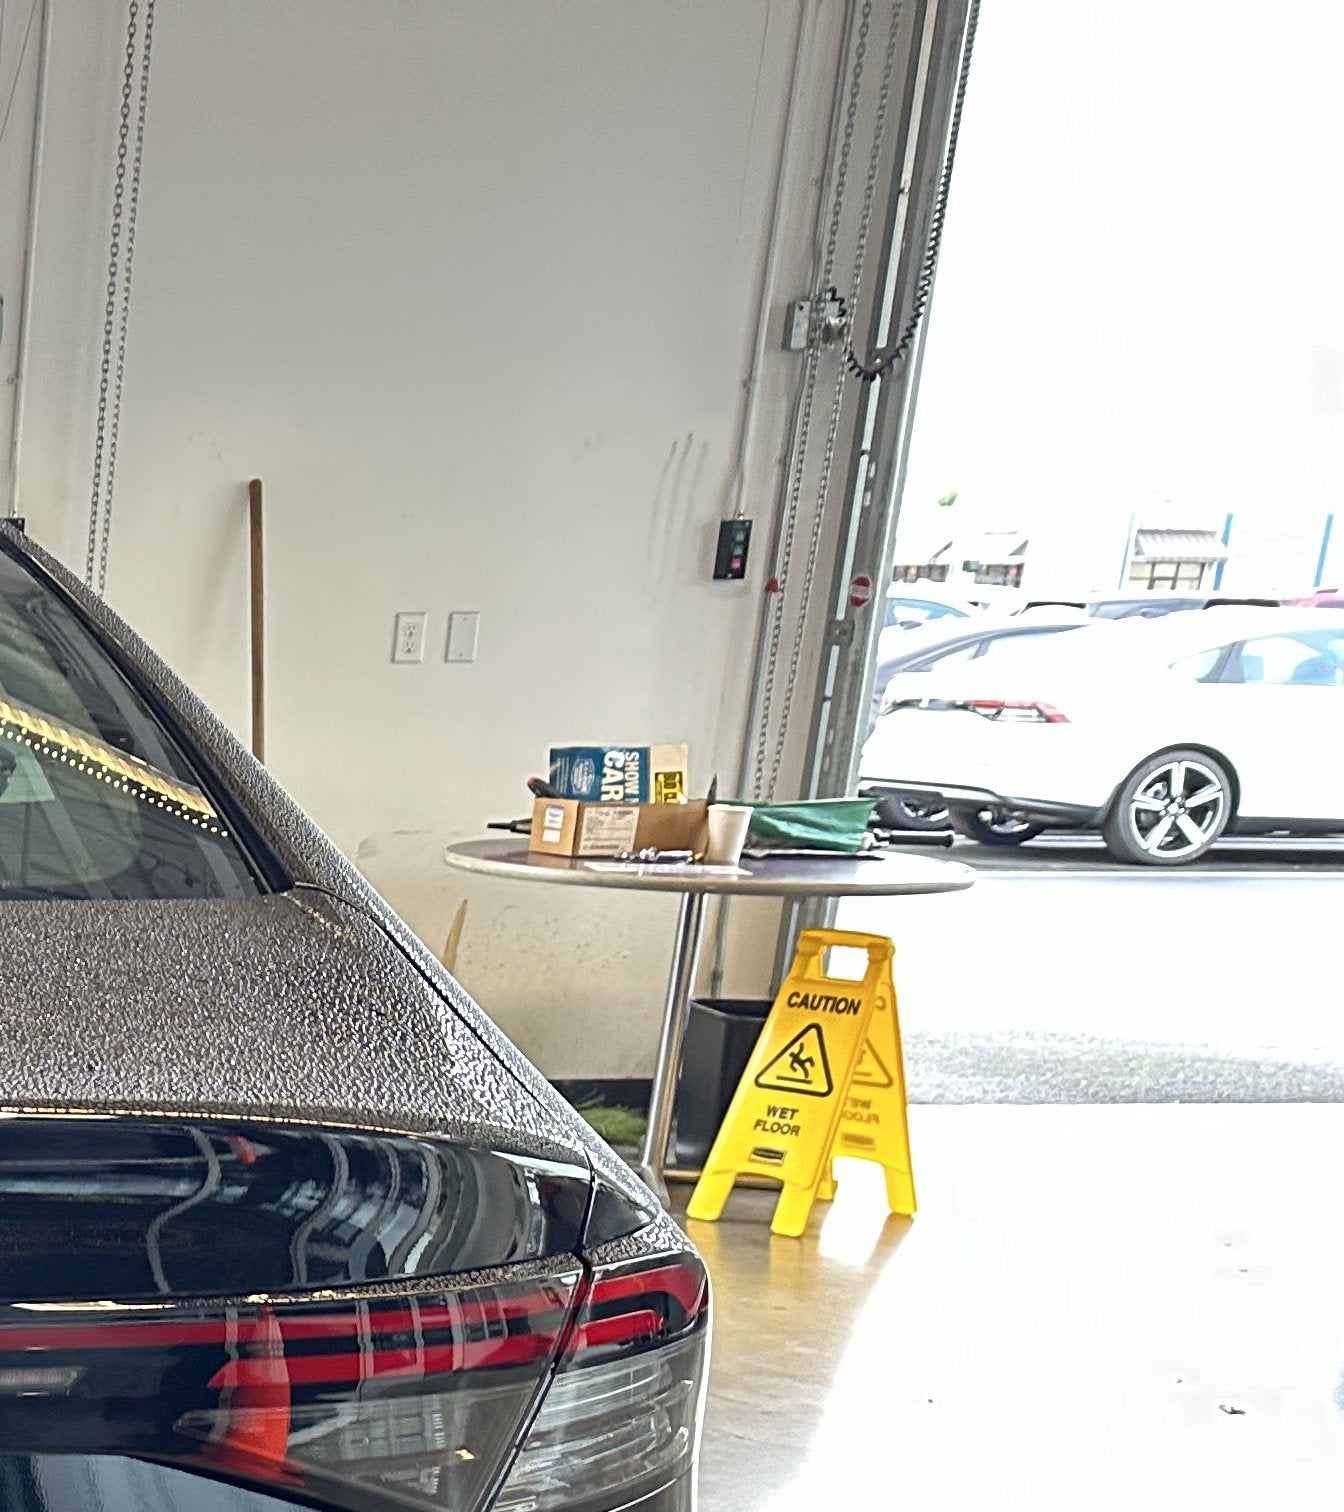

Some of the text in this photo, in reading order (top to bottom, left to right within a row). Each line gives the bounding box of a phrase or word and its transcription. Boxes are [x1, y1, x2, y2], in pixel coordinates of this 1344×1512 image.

[601, 750, 625, 801] CAR
[625, 751, 640, 792] SHOW
[787, 991, 862, 1016] CAUTION
[767, 1104, 800, 1121] WET
[753, 1118, 801, 1137] FLOOR
